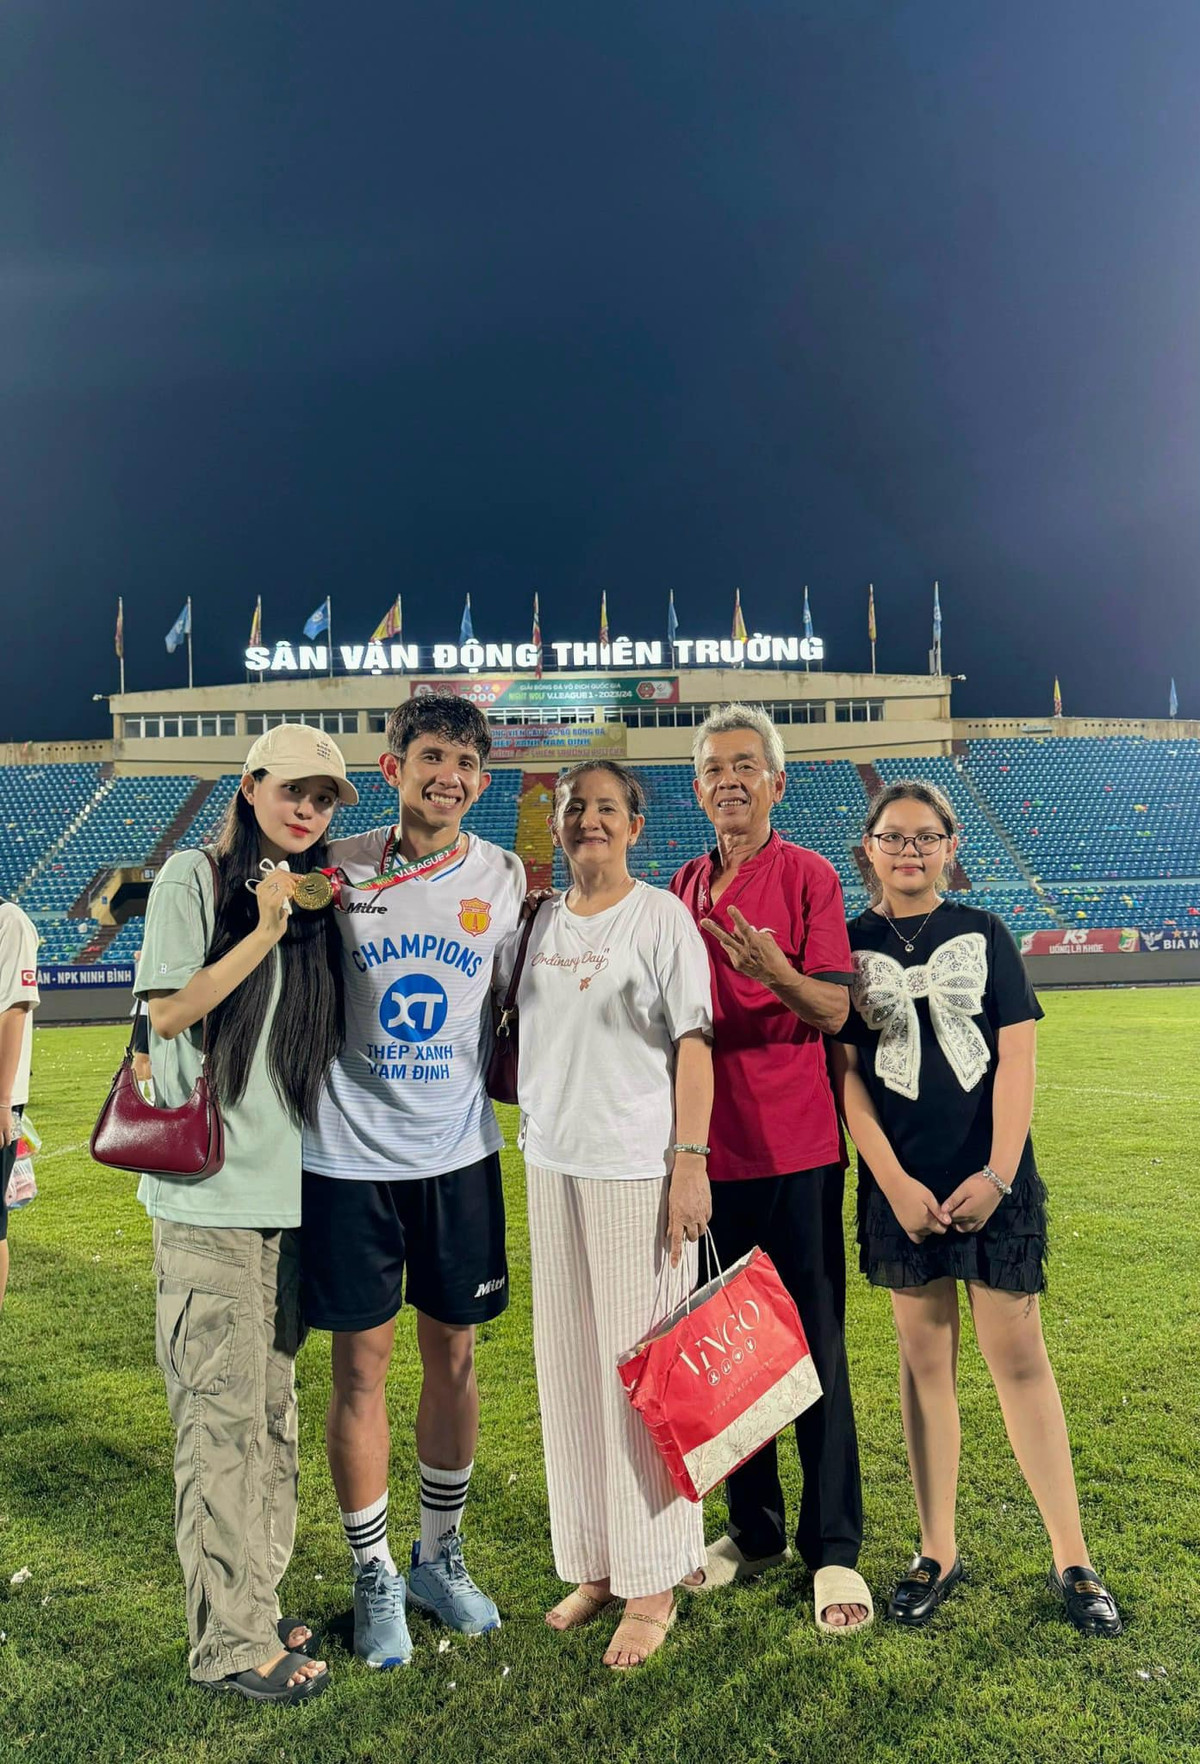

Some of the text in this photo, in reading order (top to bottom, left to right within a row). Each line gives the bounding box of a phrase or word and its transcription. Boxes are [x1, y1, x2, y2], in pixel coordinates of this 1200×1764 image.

[244, 640, 328, 671] SÂN
[339, 640, 419, 675] VẬN
[432, 638, 540, 675] ĐỘNG
[551, 635, 662, 667] THIÊN
[547, 691, 587, 699] V.LEAGUE
[396, 851, 446, 878] V.LEAGUE
[346, 902, 388, 914] Mitre
[1163, 939, 1186, 950] BIA
[352, 934, 483, 978] CHAMPIONS
[57, 971, 78, 984] NPK
[79, 971, 105, 984] NINH
[106, 967, 132, 983] BÌNH
[366, 1041, 453, 1060] THÉP XANH
[412, 1064, 450, 1084] ĐỊNH
[677, 1299, 760, 1375] VINGO
